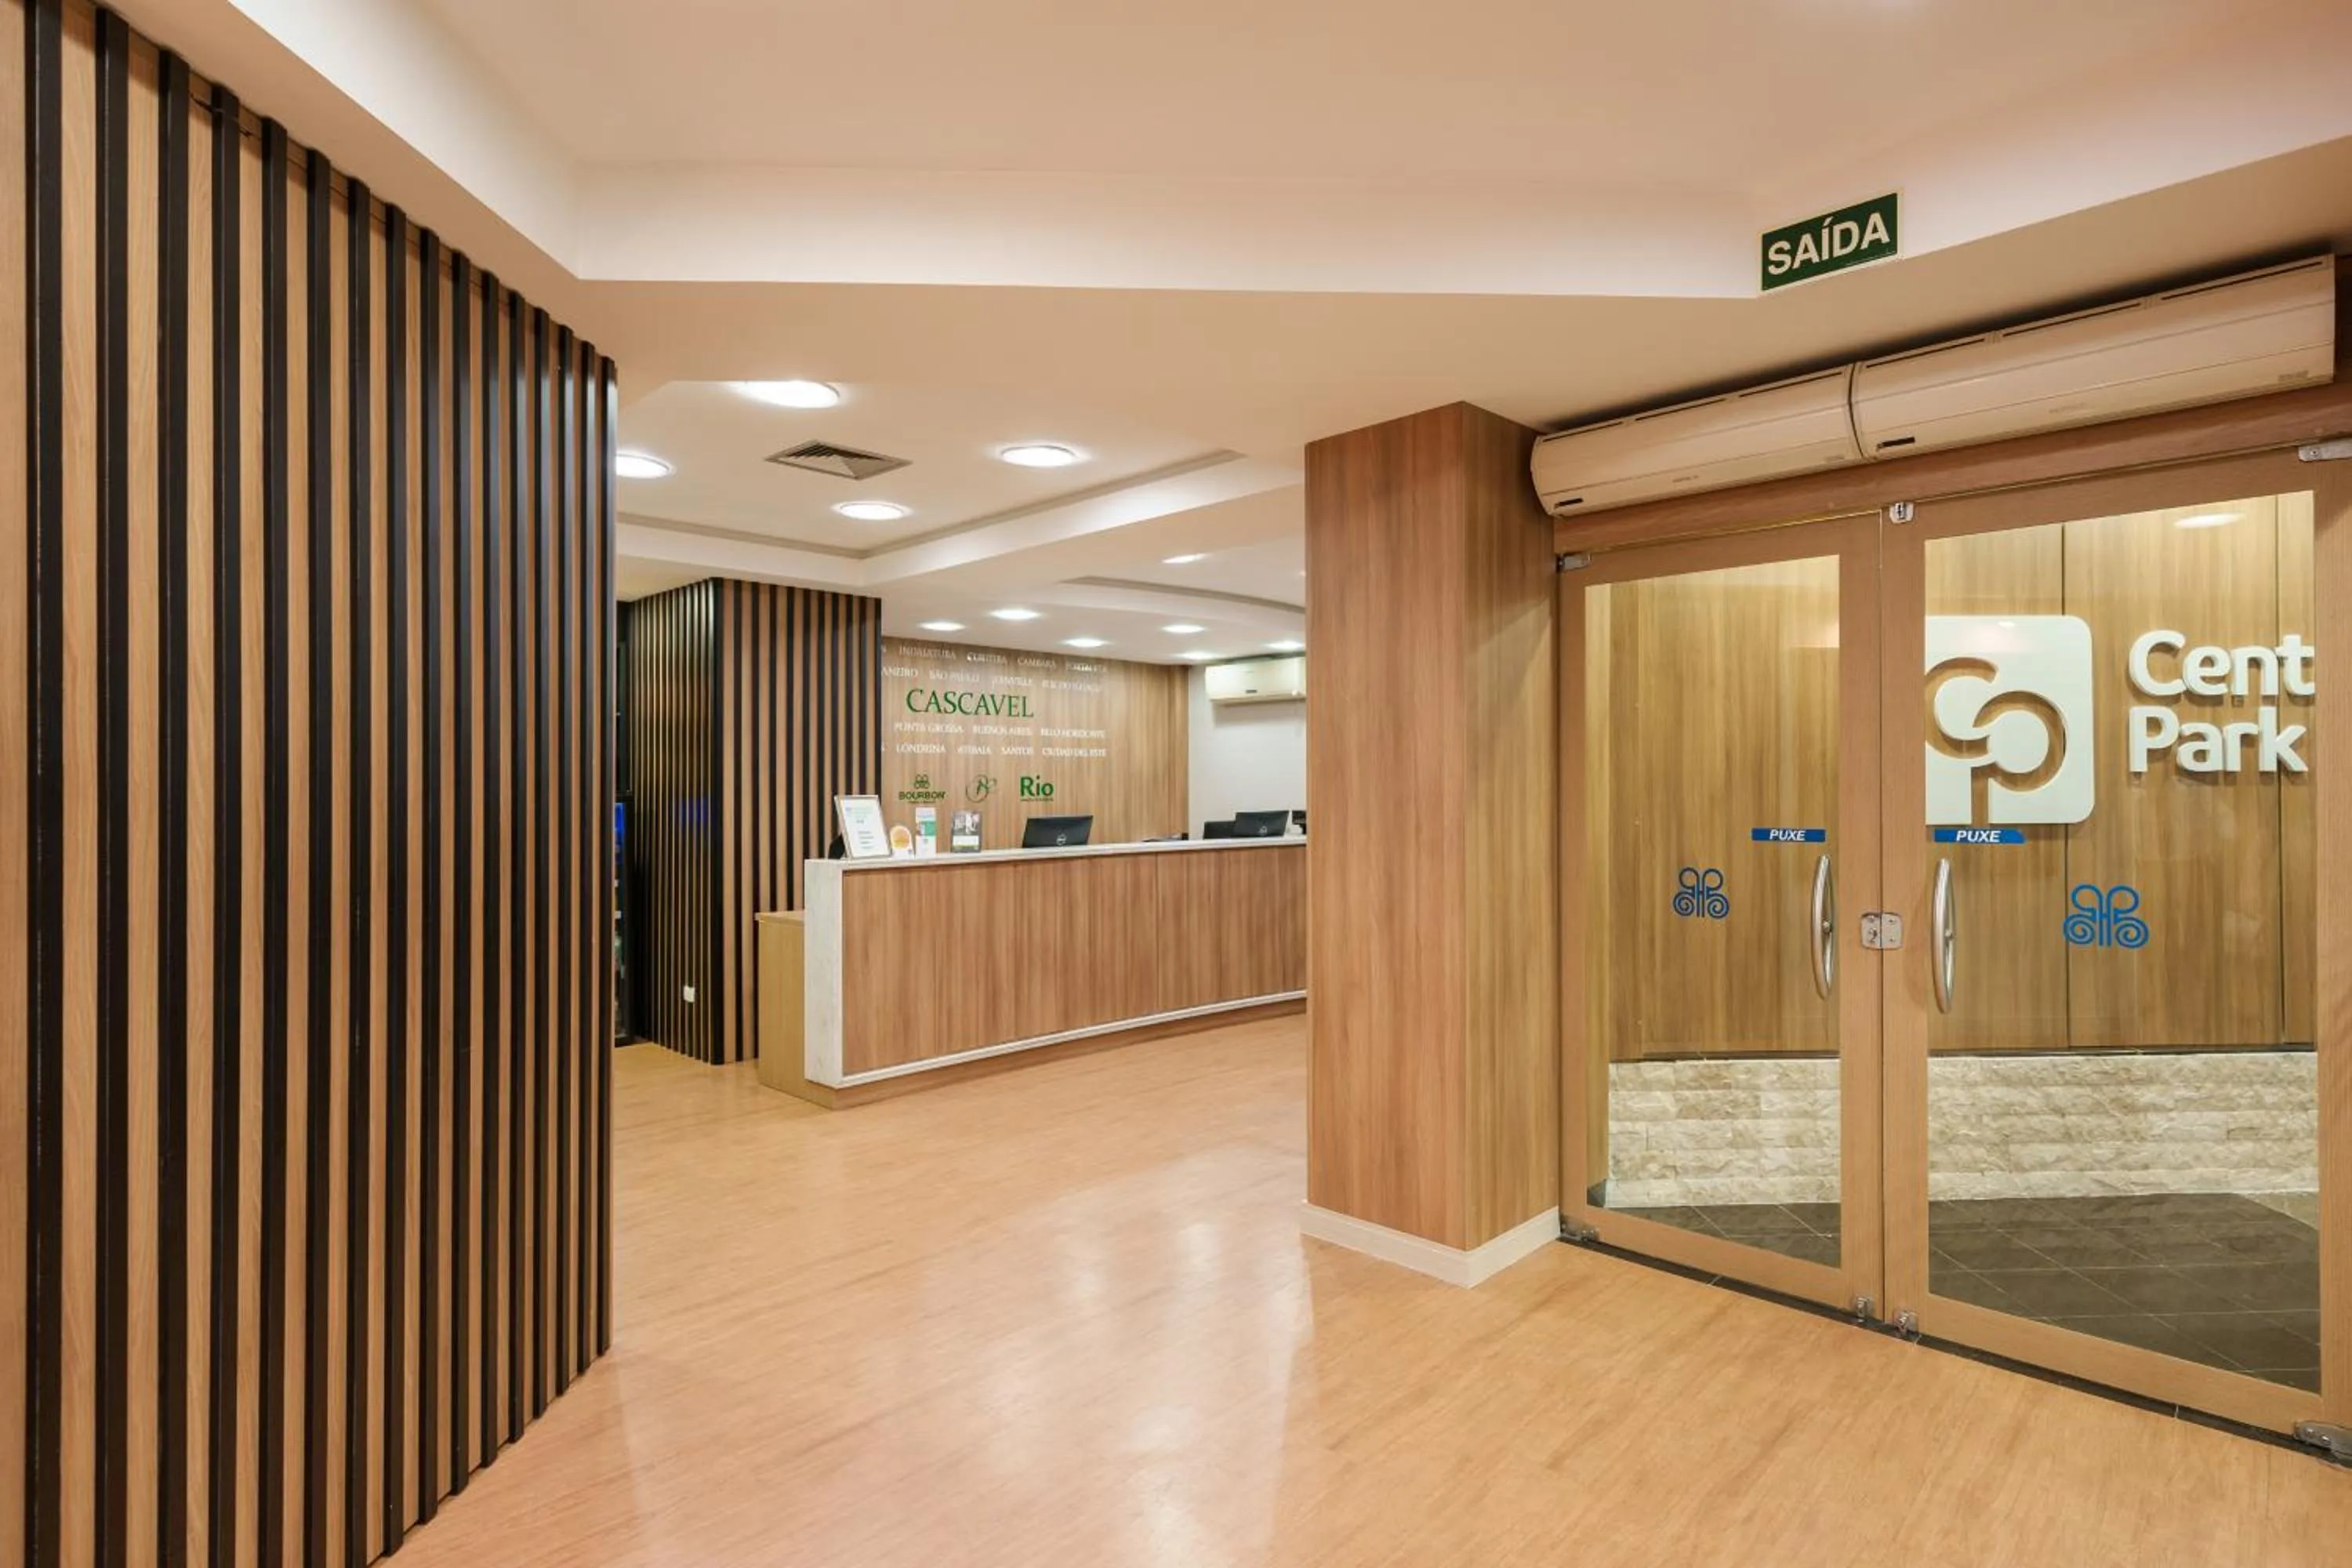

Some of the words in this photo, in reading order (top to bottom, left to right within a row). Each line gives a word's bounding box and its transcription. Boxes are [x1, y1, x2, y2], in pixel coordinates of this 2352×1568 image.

[1768, 211, 1890, 275] SAÍDA
[2129, 630, 2315, 696] Cent
[906, 688, 1034, 717] CASCAVEL
[2129, 706, 2309, 772] Park
[1020, 775, 1054, 797] Rio
[1769, 829, 1806, 841] PUXE
[1956, 830, 2002, 843] PUXE
